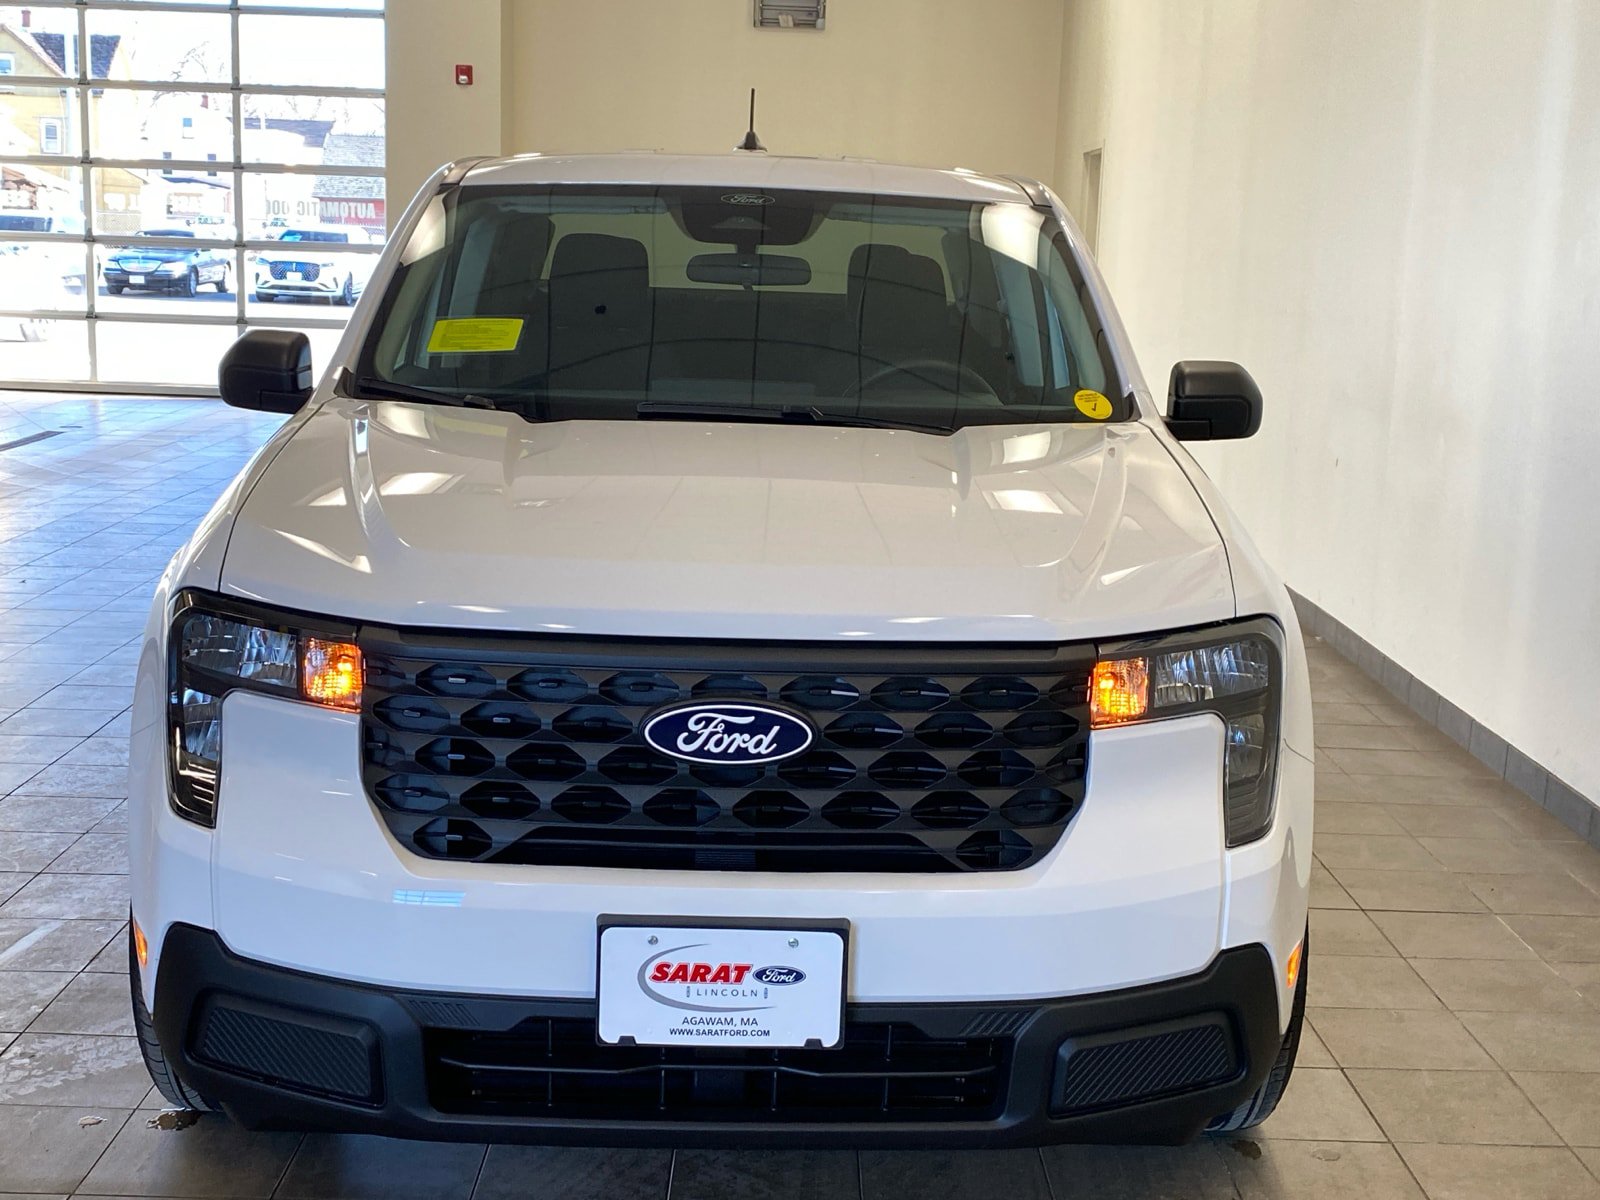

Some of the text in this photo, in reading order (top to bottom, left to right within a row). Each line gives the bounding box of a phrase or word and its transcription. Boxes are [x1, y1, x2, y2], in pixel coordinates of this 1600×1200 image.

[676, 712, 781, 755] Ford
[650, 962, 796, 985] SARAT Ford
[696, 988, 758, 998] LINCOLN
[681, 1016, 759, 1028] AGAWAM, MA
[669, 1028, 771, 1038] WWW.SARATFORD.COM
